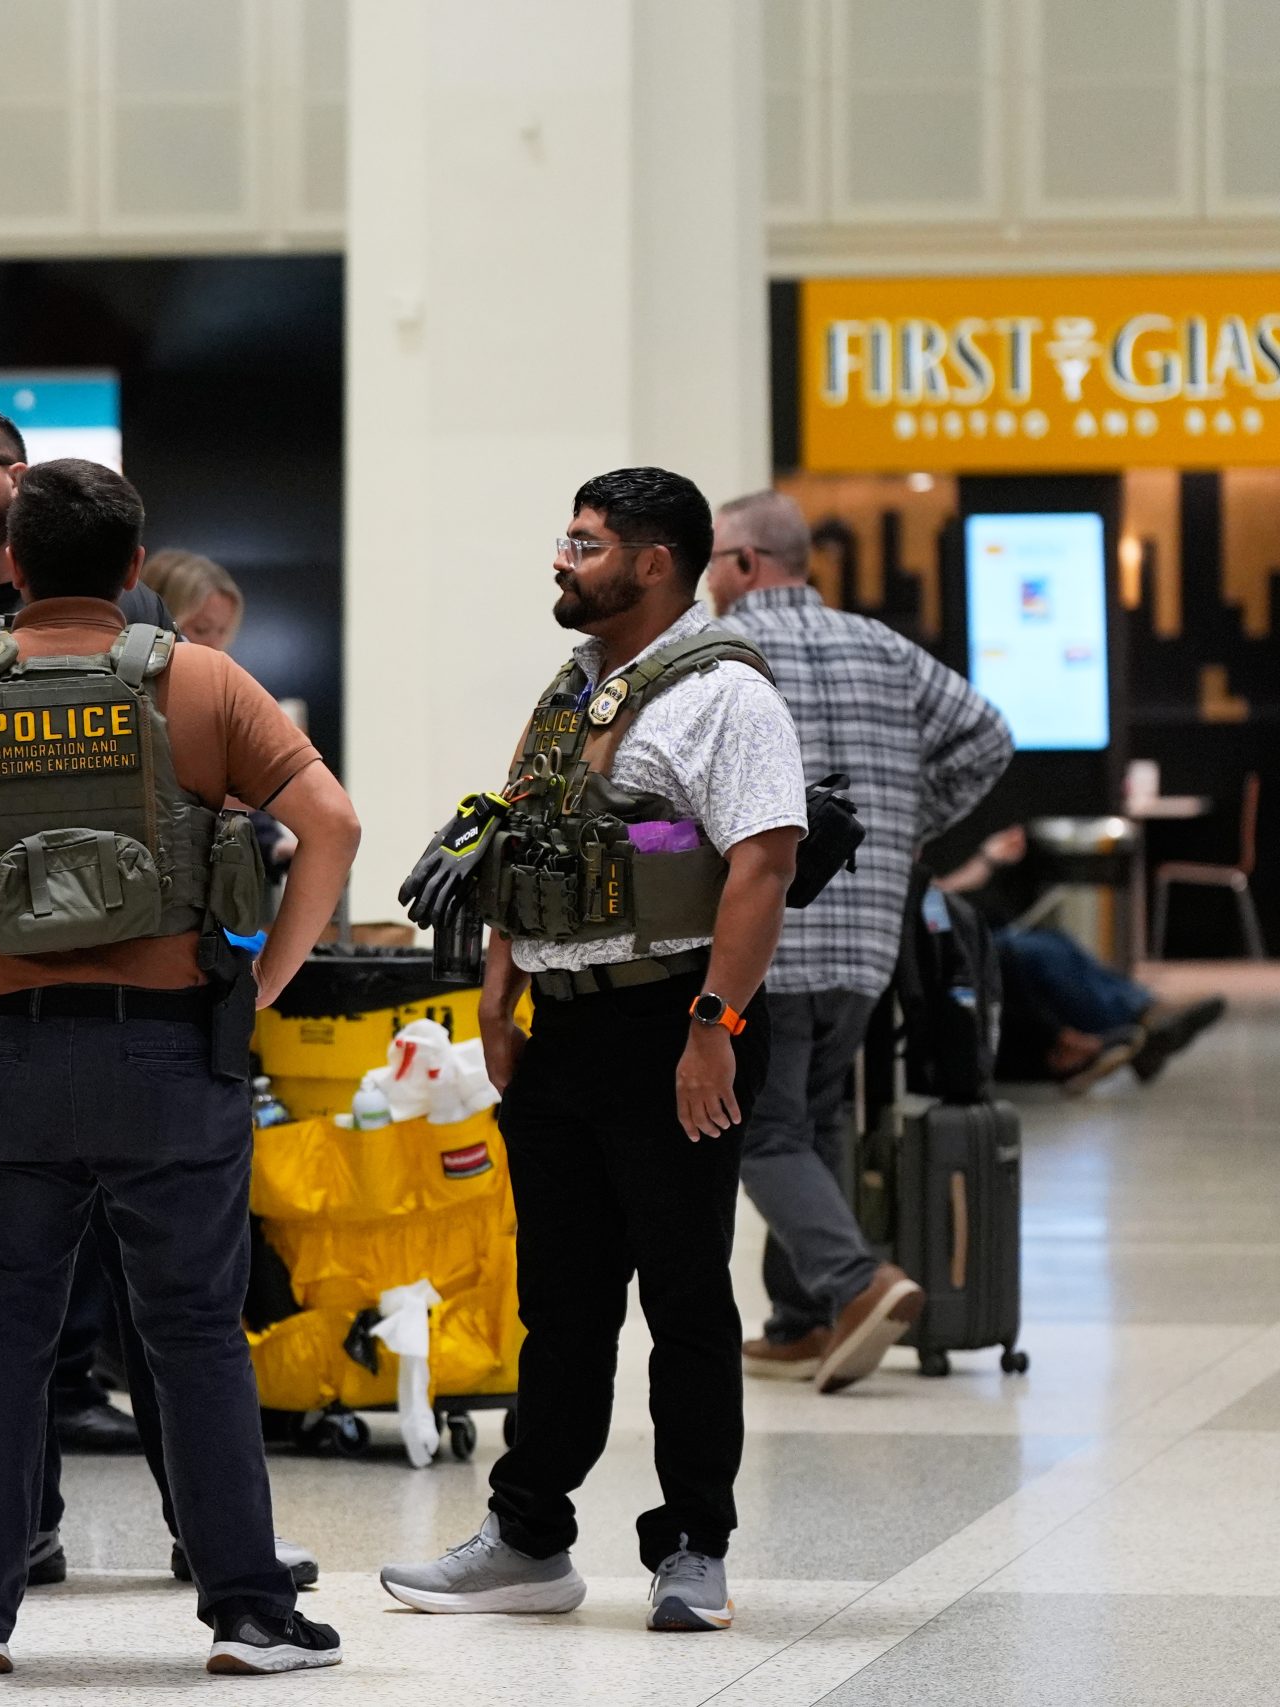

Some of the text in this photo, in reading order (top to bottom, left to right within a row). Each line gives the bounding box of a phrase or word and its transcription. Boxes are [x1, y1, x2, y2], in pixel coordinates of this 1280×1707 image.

[823, 314, 1044, 407] FIRST
[91, 739, 118, 753] AND
[47, 752, 137, 772] ENFORCEMENT
[454, 825, 479, 848] RYOBI
[608, 863, 619, 914] ICE
